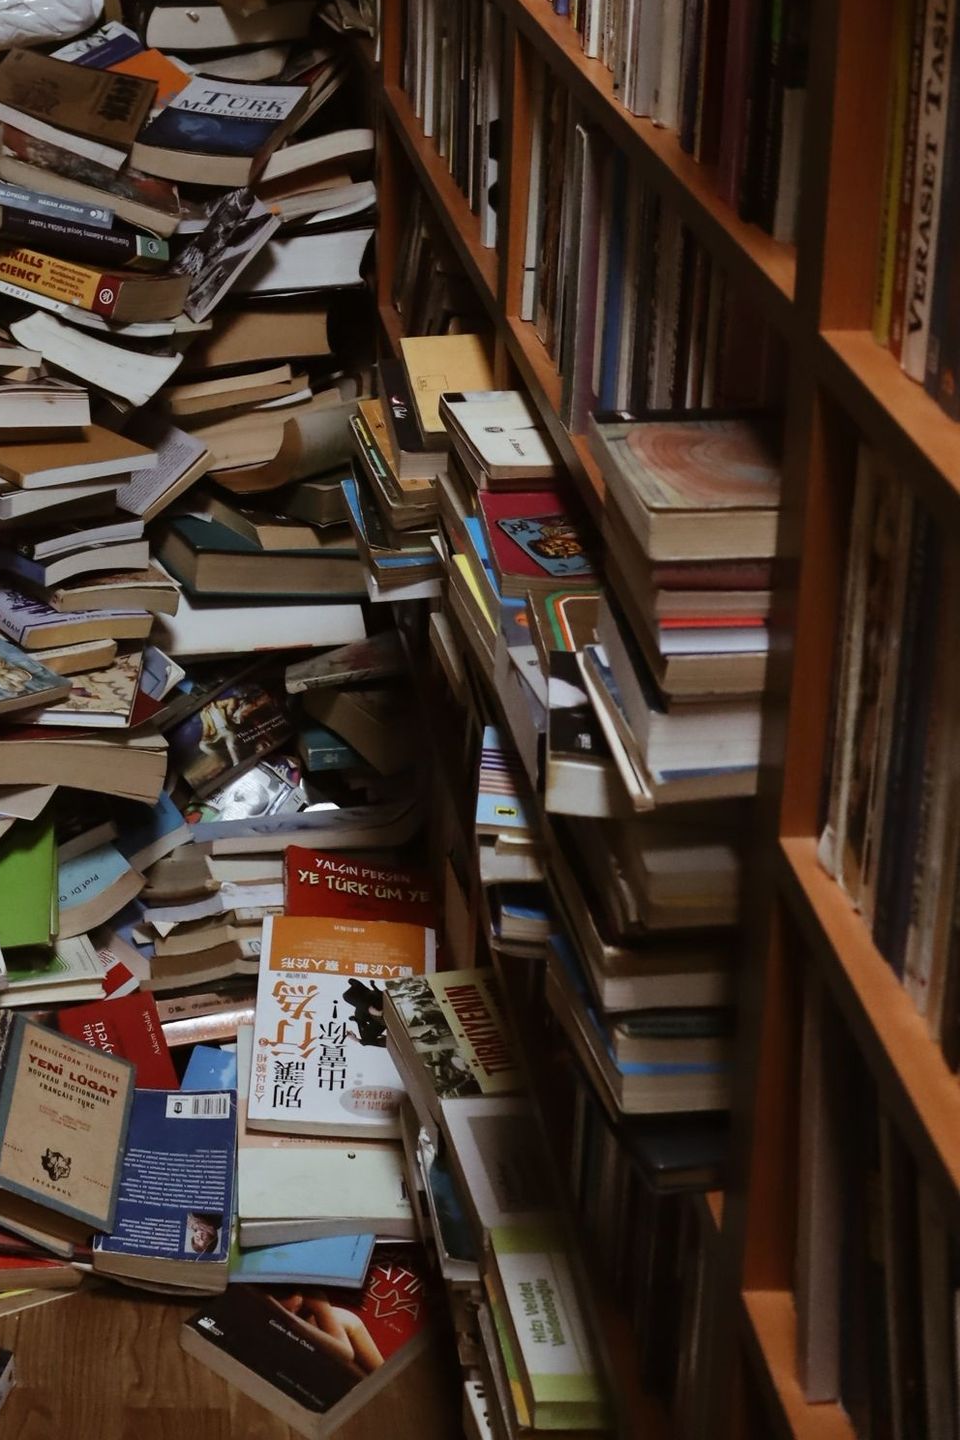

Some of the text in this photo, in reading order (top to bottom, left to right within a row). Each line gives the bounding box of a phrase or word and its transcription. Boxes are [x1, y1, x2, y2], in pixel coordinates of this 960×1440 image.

[203, 90, 288, 114] TÜRK
[907, 132, 940, 335] VERASET
[2, 617, 21, 634] ADAM
[297, 869, 321, 885] YE
[326, 875, 403, 902] TÜRK'ÜM
[314, 857, 359, 877] YALÇIN
[271, 981, 318, 1109] 別讓行為
[317, 1000, 347, 1091] 出賣你！
[442, 985, 512, 1076] TÜRKİYENİN
[26, 1054, 65, 1076] YENİ
[26, 1066, 111, 1106] NOUVEAU DICTIONNAIRE
[516, 1281, 542, 1317] Veldet
[535, 1278, 565, 1346] Velidedeoğlu
